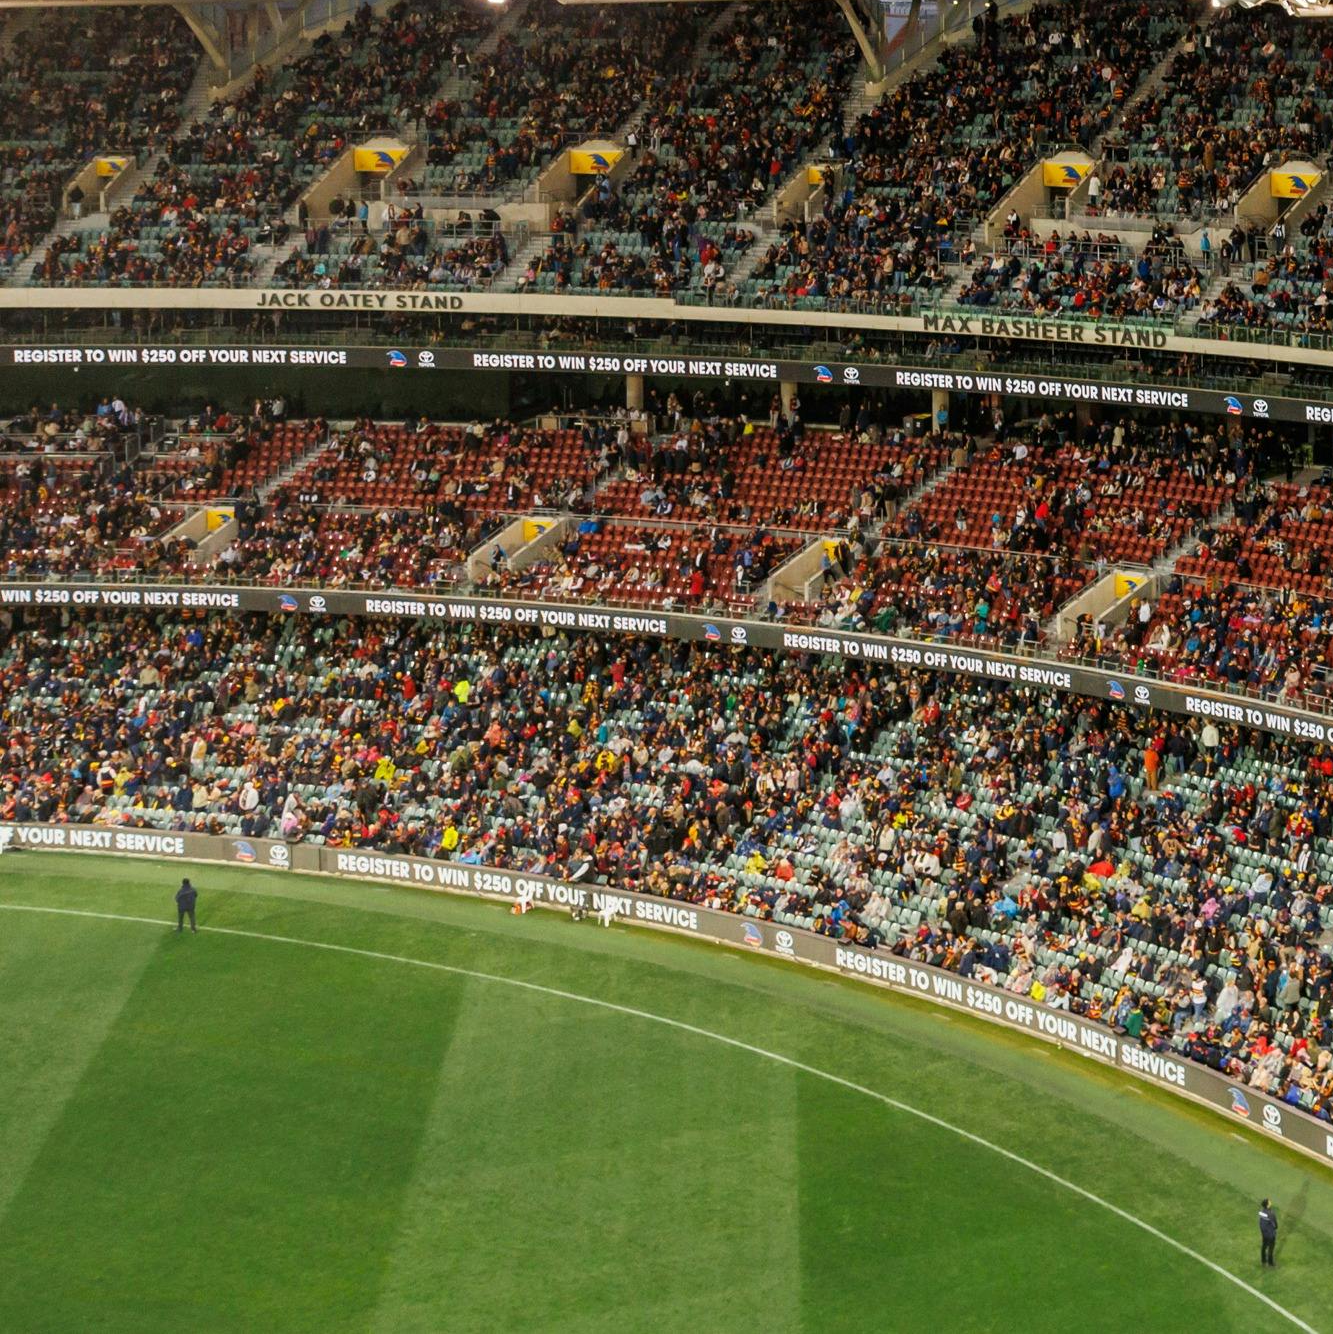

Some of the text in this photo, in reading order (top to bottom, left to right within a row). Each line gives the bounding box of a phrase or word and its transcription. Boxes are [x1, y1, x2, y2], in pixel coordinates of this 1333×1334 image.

[256, 292, 463, 310] JACK OATEY STAND
[923, 313, 1167, 349] MAX BASHEER STAND
[13, 349, 347, 364] REGISTER TO WIN $250 OFF YOUR NEXT SERVICE
[473, 353, 777, 378] REGISTER TO WIN $250 OFF YOUR NEXT SERVICE
[896, 371, 1188, 408] REGISTER TO WIN $250 OFF YOUR NEXT SERVICE
[0, 589, 239, 607] WIN $250 OFF YOUR NEXT SERVICE
[365, 599, 667, 633] REGISTER TO WIN $250 OFF YOUR NEXT SERVICE
[783, 633, 1071, 688] REGISTER TO WIN $250 OFF YOUR NEXT SERVICE
[1185, 696, 1244, 722] REGISTER
[1245, 709, 1263, 726] TO
[1265, 713, 1291, 733] WIN
[1293, 720, 1325, 740] $250
[16, 826, 66, 845] YOUR
[69, 831, 113, 848] NEXT
[115, 833, 184, 854] SERVICE
[338, 854, 409, 878] REGISTER
[414, 864, 433, 882] TO
[438, 868, 468, 888] WIN
[474, 873, 511, 894] $250
[636, 902, 697, 929] SERVICE
[836, 946, 1185, 1086] REGISTER TO WIN $250 OFF YOUR NEXT SERVICE
